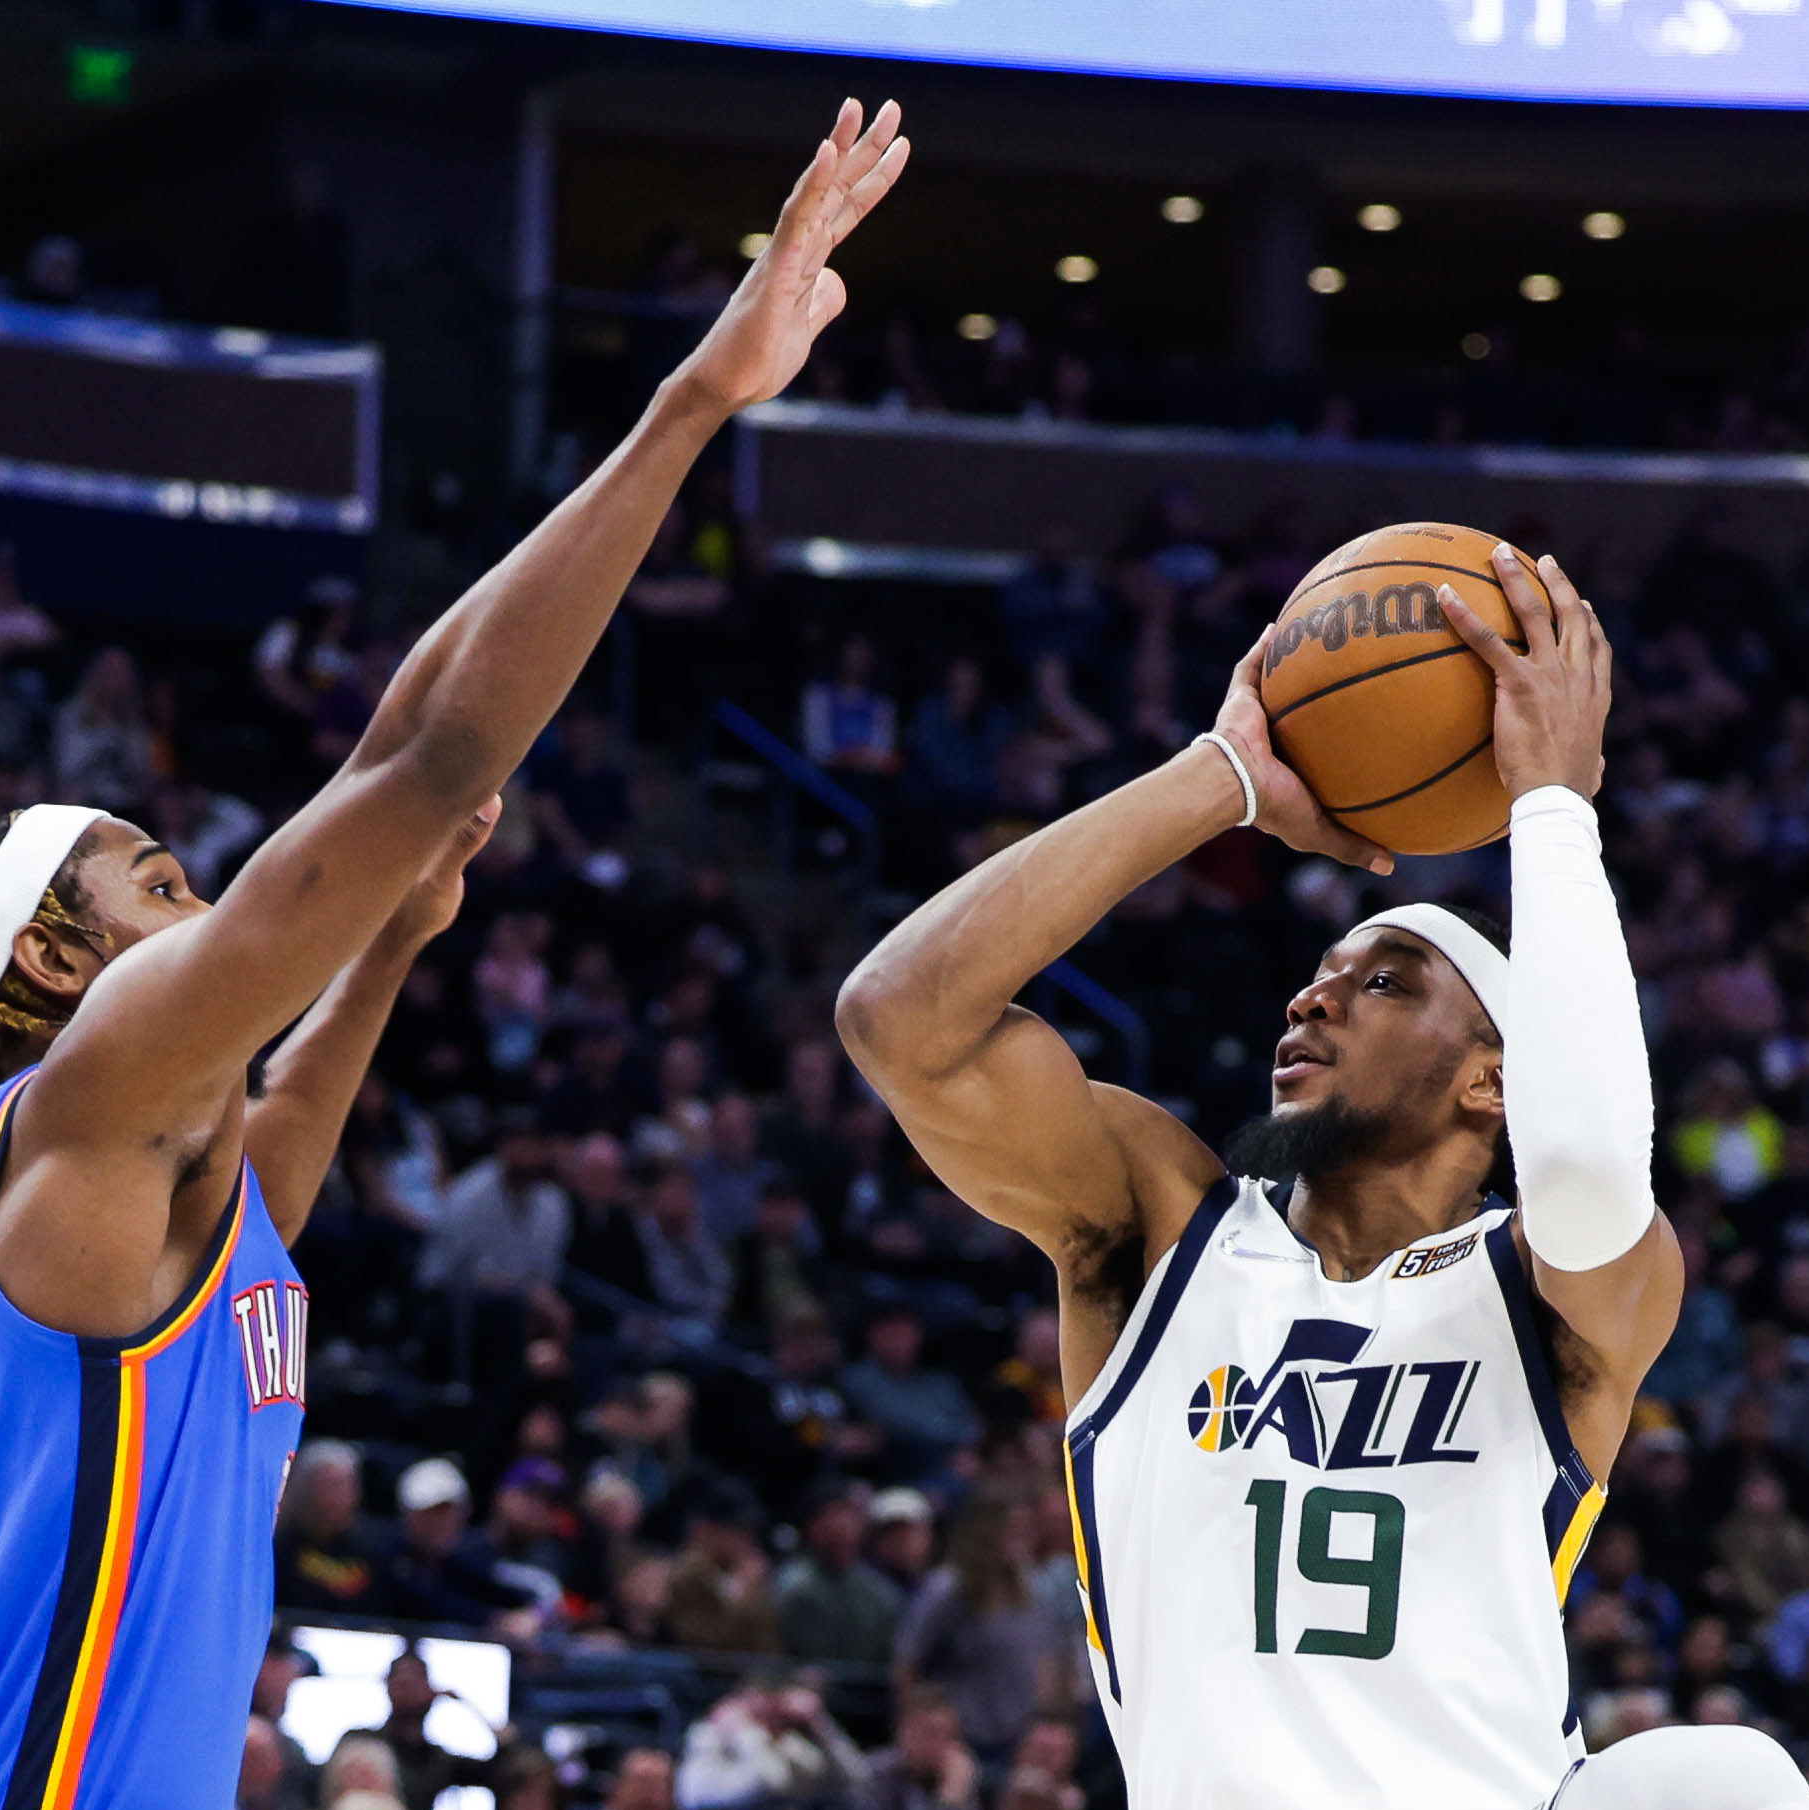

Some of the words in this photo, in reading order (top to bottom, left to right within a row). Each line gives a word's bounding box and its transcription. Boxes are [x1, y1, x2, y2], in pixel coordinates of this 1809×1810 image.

[1398, 1250, 1428, 1277] 5
[1425, 1243, 1472, 1273] FIGHT
[1245, 1478, 1406, 1660] 19
